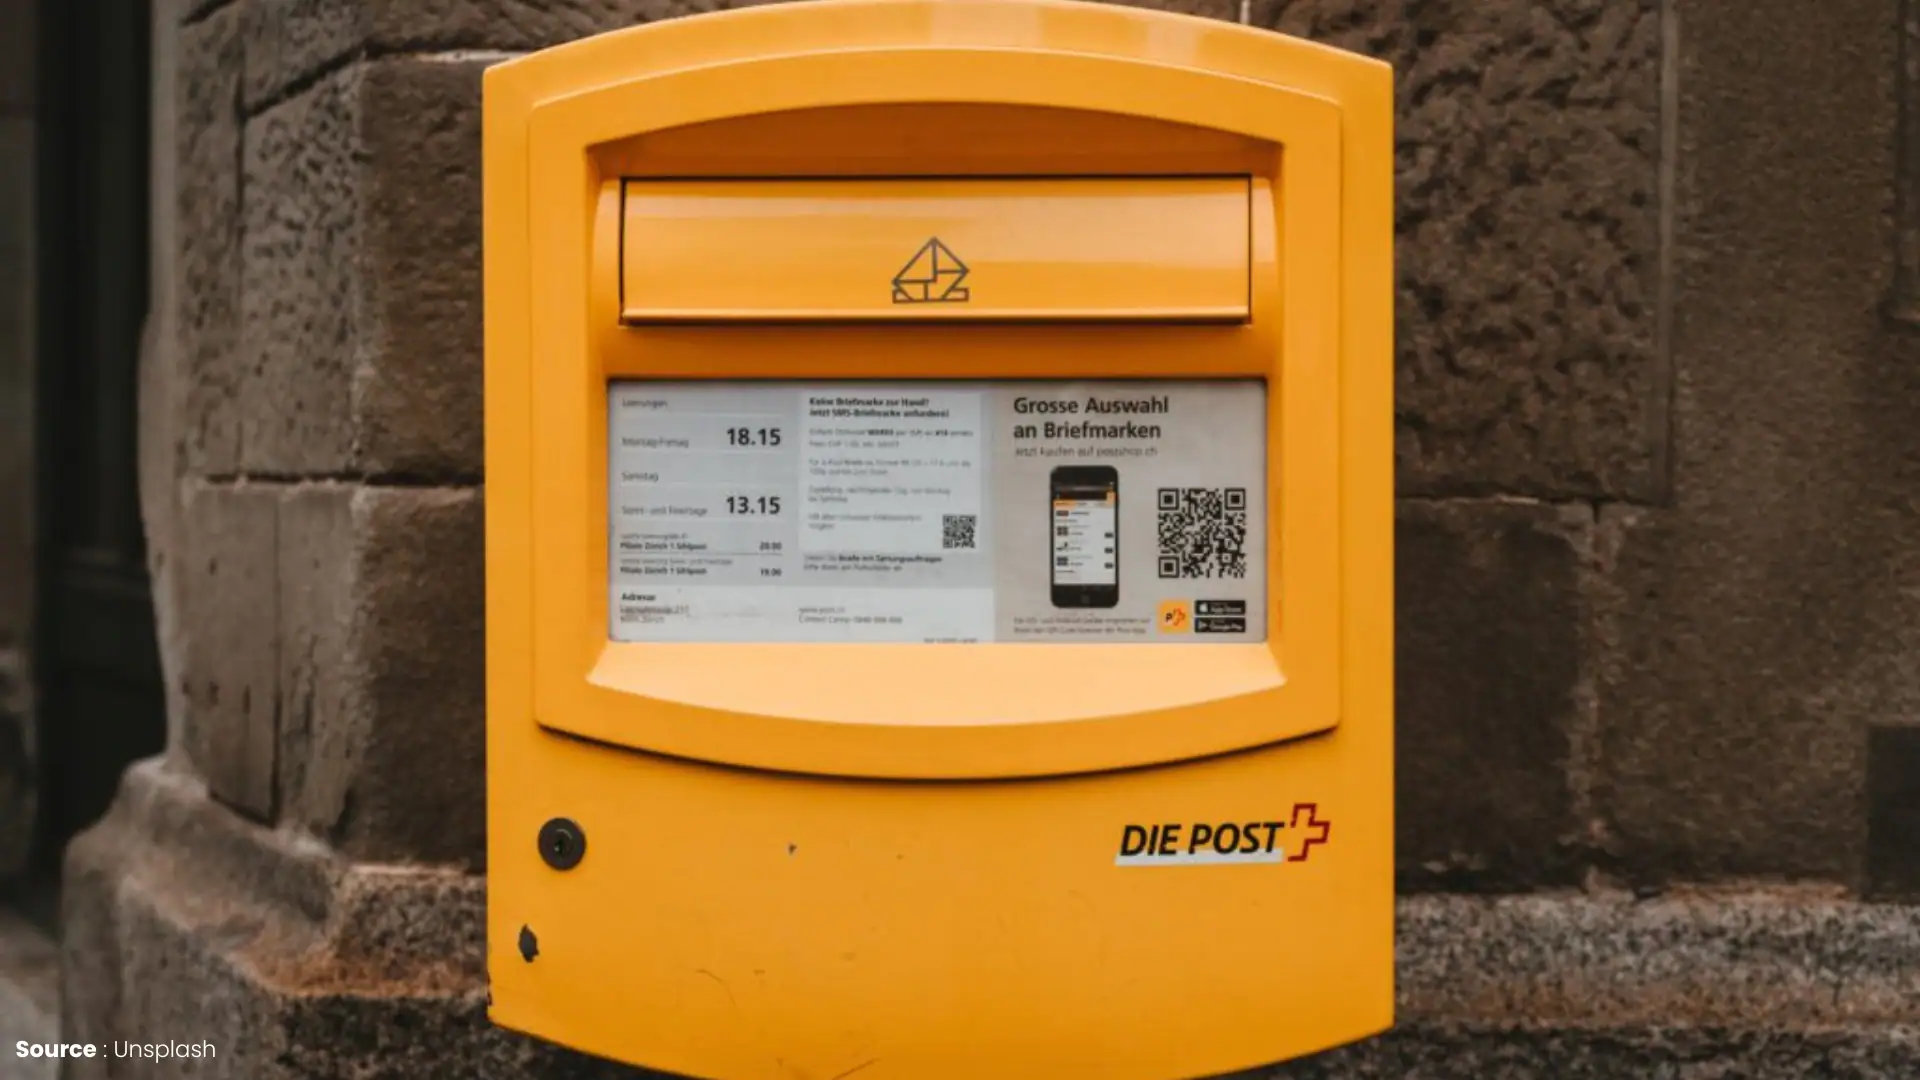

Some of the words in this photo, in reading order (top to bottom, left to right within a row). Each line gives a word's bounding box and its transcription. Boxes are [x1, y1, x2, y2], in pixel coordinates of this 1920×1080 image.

[1014, 397, 1078, 413] Grosse
[1085, 396, 1169, 414] Auswahl
[726, 427, 781, 446] 18.15
[1014, 425, 1037, 439] an
[1044, 421, 1161, 438] Briefmarken
[1040, 447, 1074, 456] kaufen
[1078, 446, 1093, 456] auf
[726, 496, 781, 515] 13.15
[1120, 825, 1182, 857] DIE
[1188, 821, 1285, 855] POST
